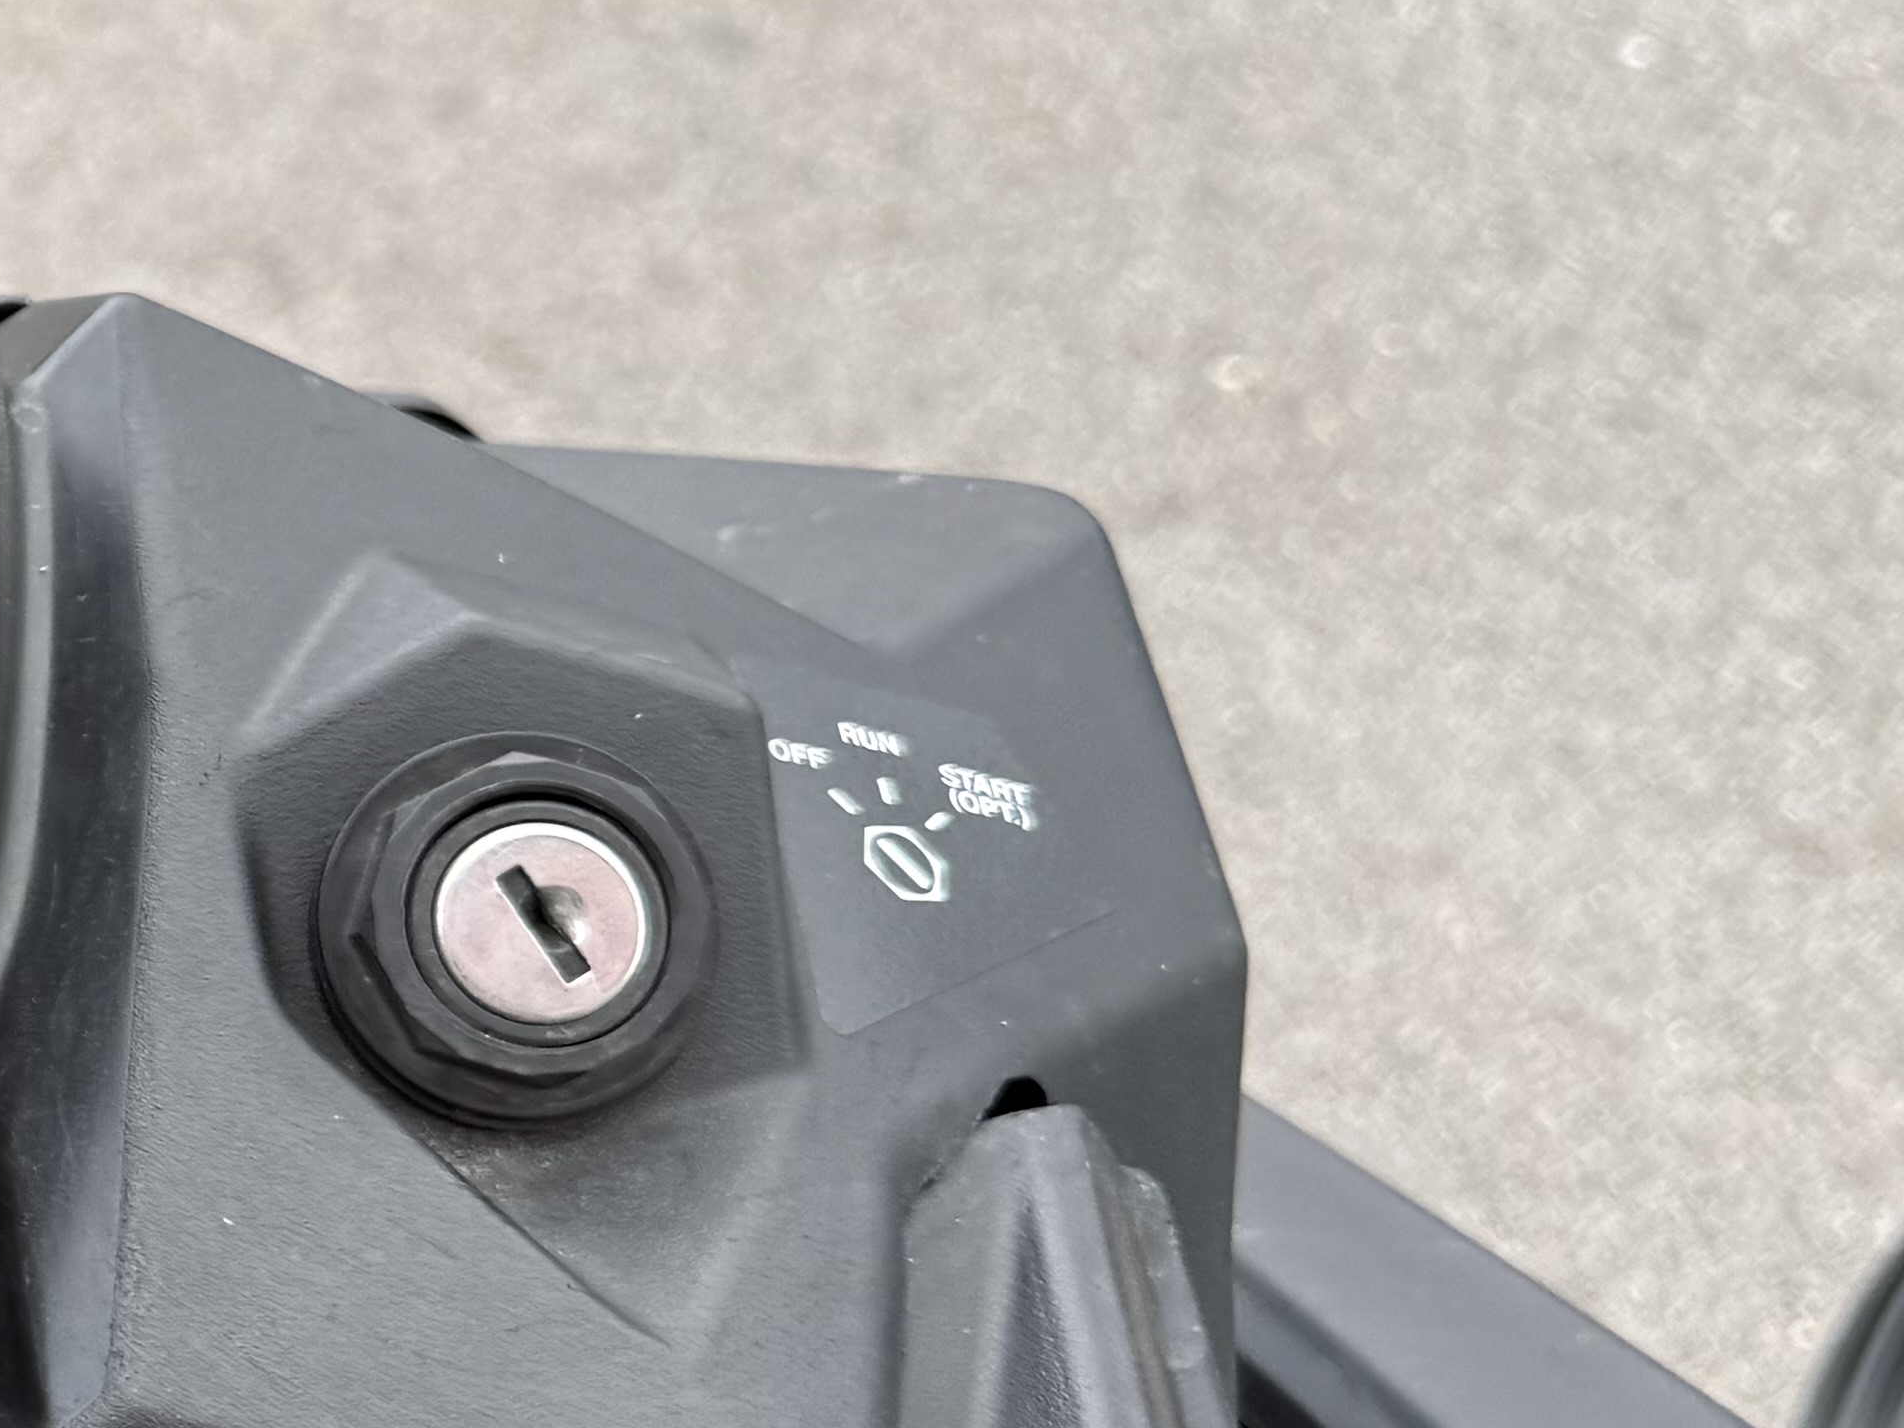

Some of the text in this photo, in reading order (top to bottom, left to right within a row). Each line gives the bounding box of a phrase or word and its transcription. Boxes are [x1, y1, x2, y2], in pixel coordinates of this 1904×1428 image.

[768, 738, 835, 769] OFF
[837, 721, 910, 757] RUN
[938, 763, 1035, 806] START
